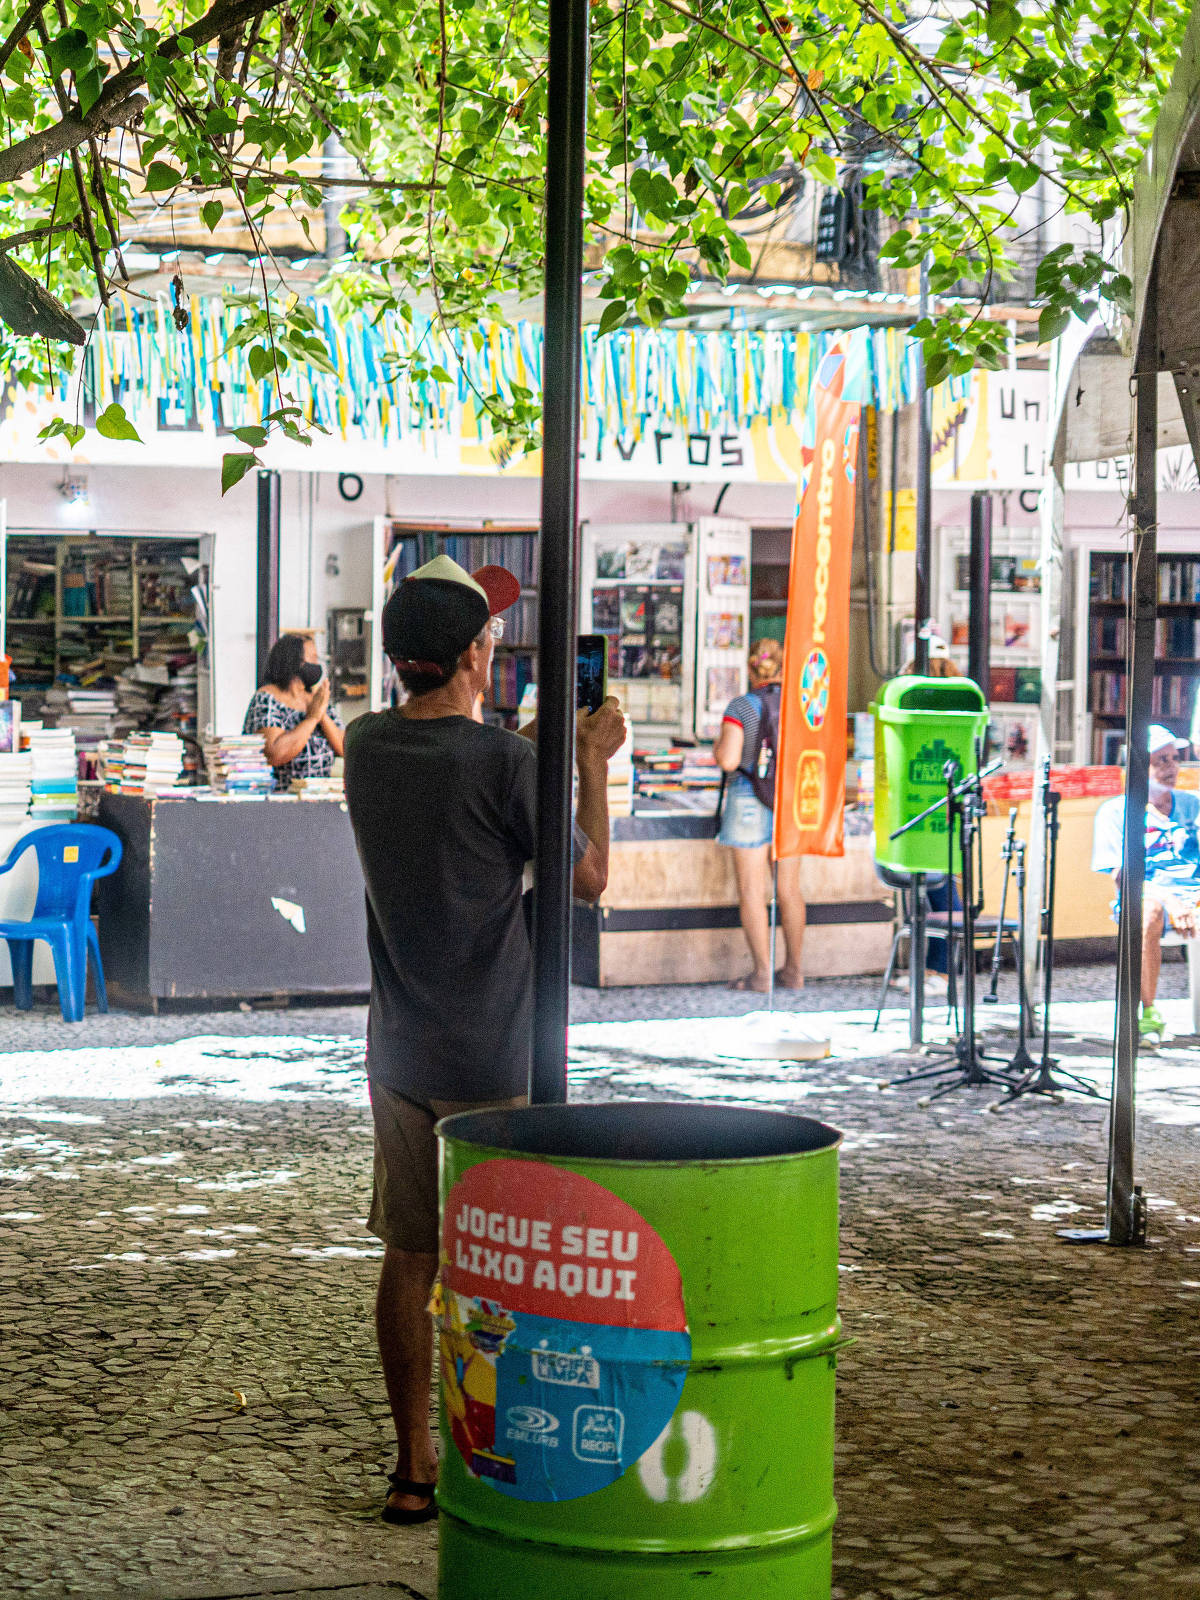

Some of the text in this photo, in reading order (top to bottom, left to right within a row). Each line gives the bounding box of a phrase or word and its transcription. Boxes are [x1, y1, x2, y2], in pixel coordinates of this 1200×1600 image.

[580, 428, 743, 467] ivros
[456, 1204, 638, 1261] JOGUE SEU
[456, 1239, 637, 1301] LIXO AQUI
